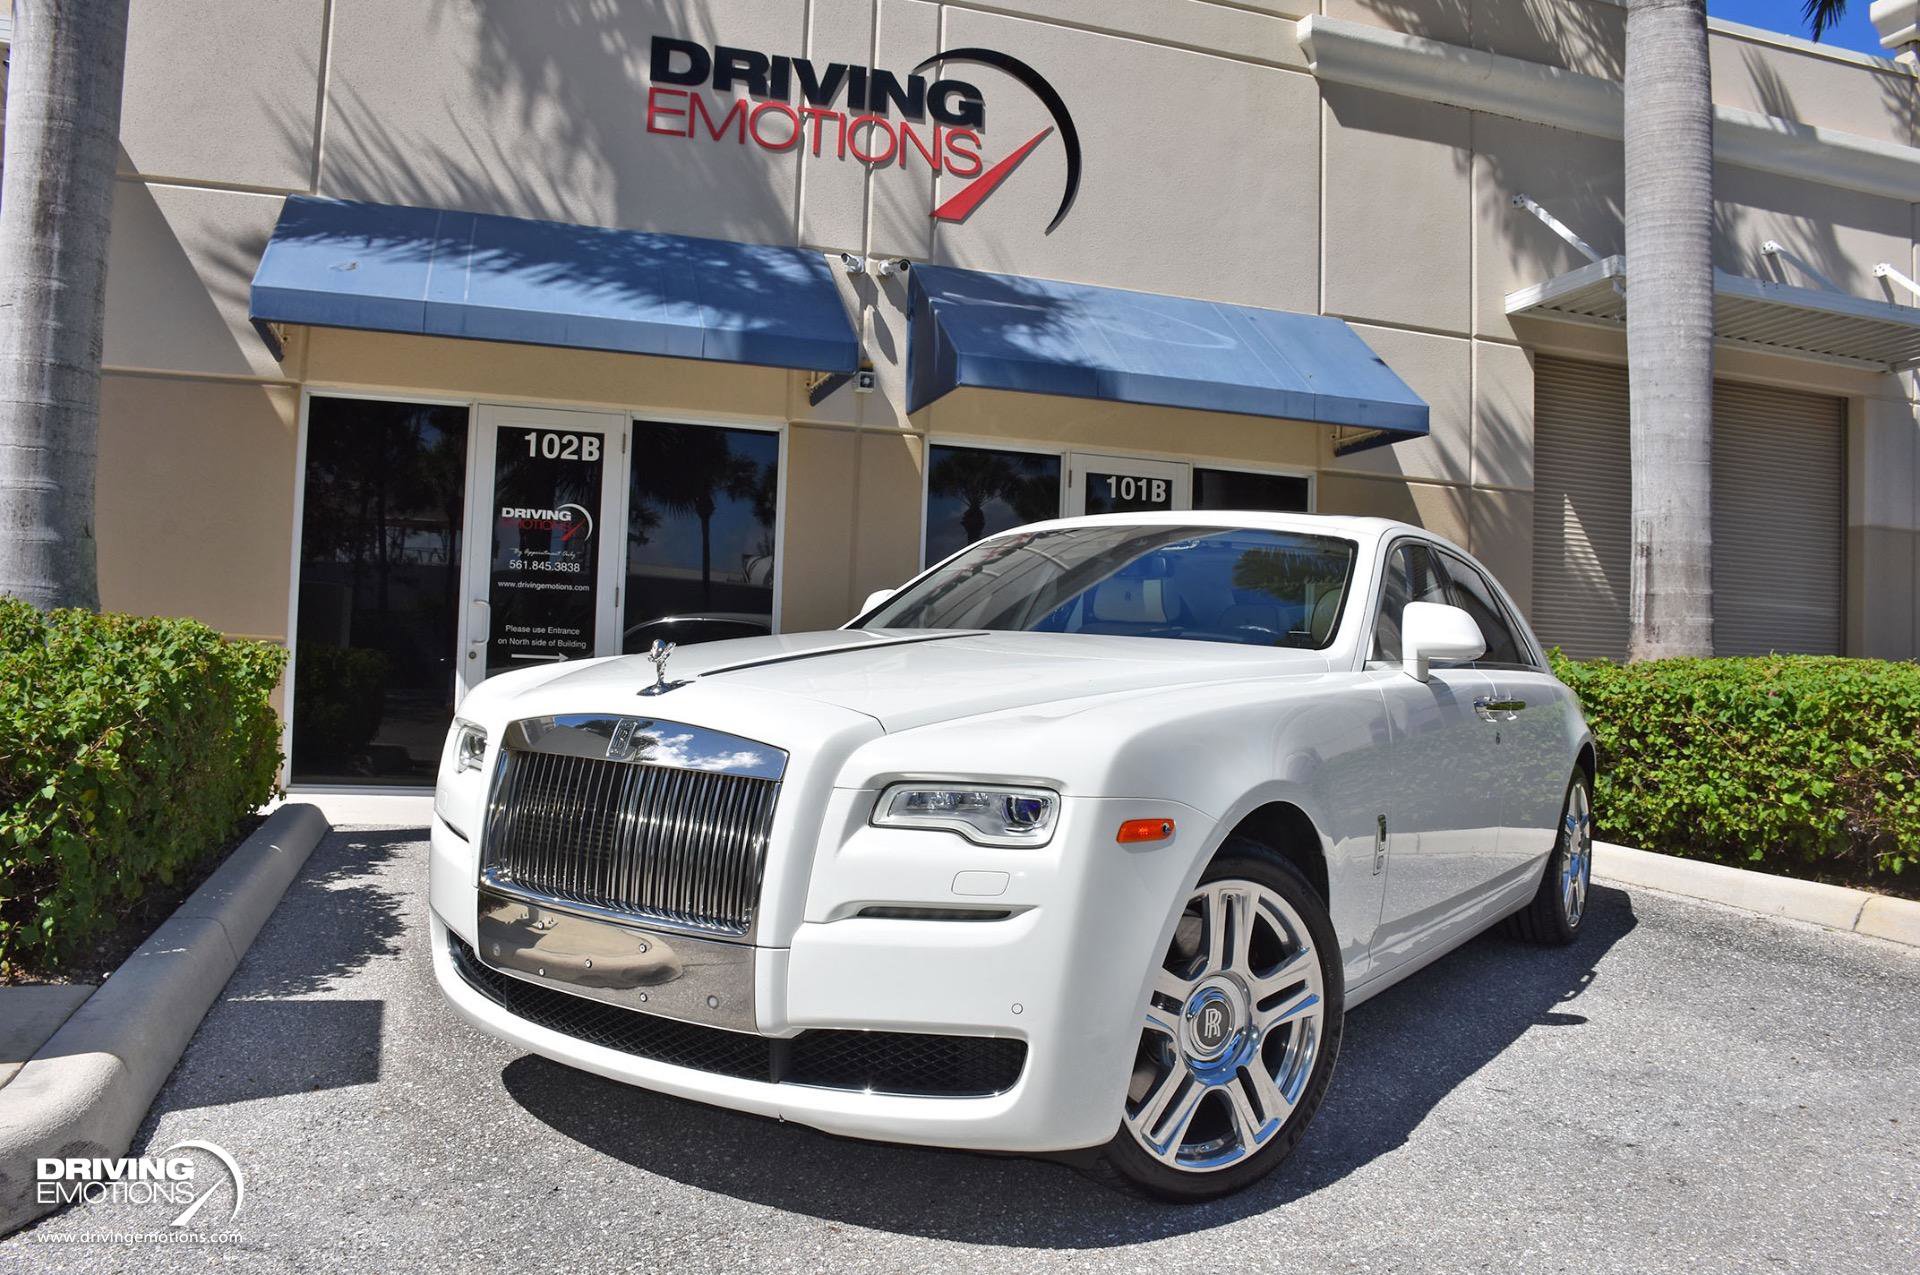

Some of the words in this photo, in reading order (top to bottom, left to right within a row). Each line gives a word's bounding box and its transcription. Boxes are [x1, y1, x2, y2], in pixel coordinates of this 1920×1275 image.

[650, 36, 985, 128] DRIVING
[646, 87, 983, 177] EMOTIONS
[524, 432, 600, 461] 102B
[1106, 476, 1167, 503] 101B
[502, 507, 572, 521] DRIVING
[500, 518, 573, 531] OTIO
[509, 559, 580, 573] 561.845.3838
[497, 581, 590, 592] www.drivingemotions.com
[505, 624, 531, 633] Please
[547, 626, 580, 635] Entrance
[497, 637, 508, 645] on
[509, 637, 530, 645] North
[531, 638, 547, 646] side
[548, 639, 556, 647] of
[557, 639, 587, 649] Building
